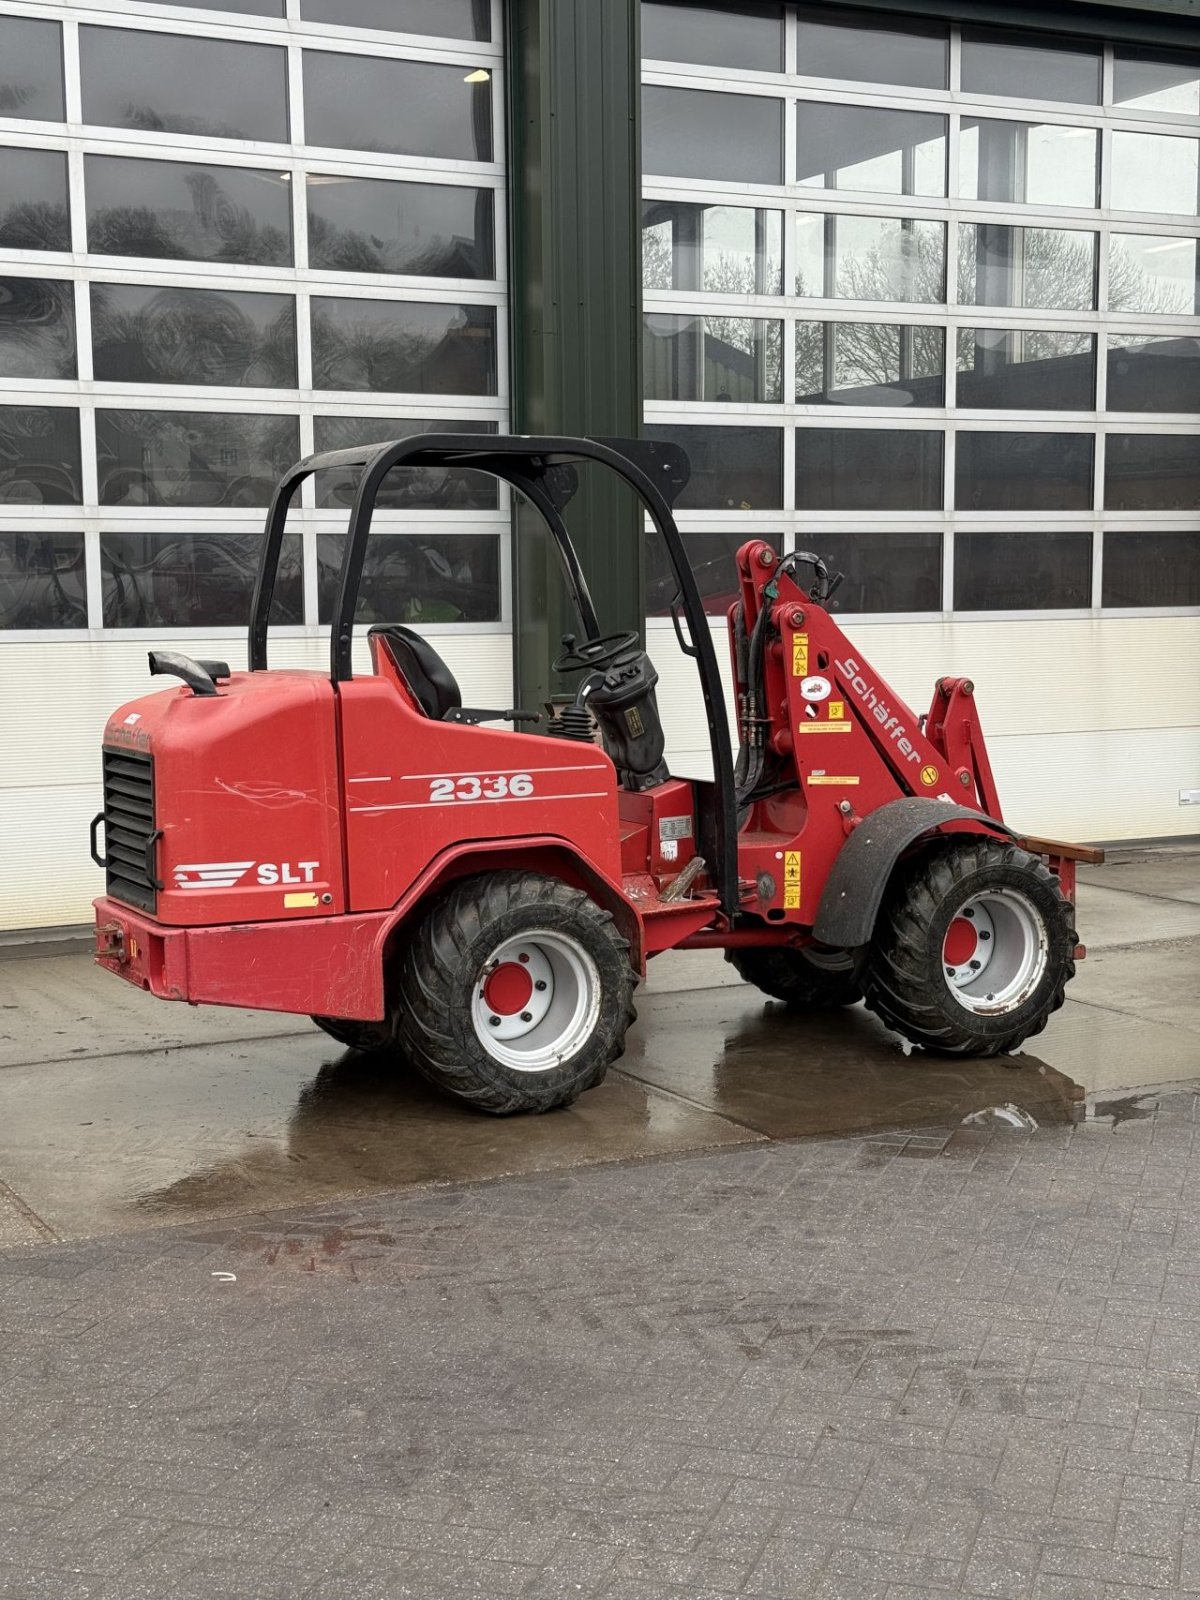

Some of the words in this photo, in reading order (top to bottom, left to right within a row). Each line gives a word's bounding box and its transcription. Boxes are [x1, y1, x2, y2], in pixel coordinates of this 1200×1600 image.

[834, 658, 921, 764] Schäffer
[429, 773, 534, 802] 2336
[256, 861, 320, 885] SLT
